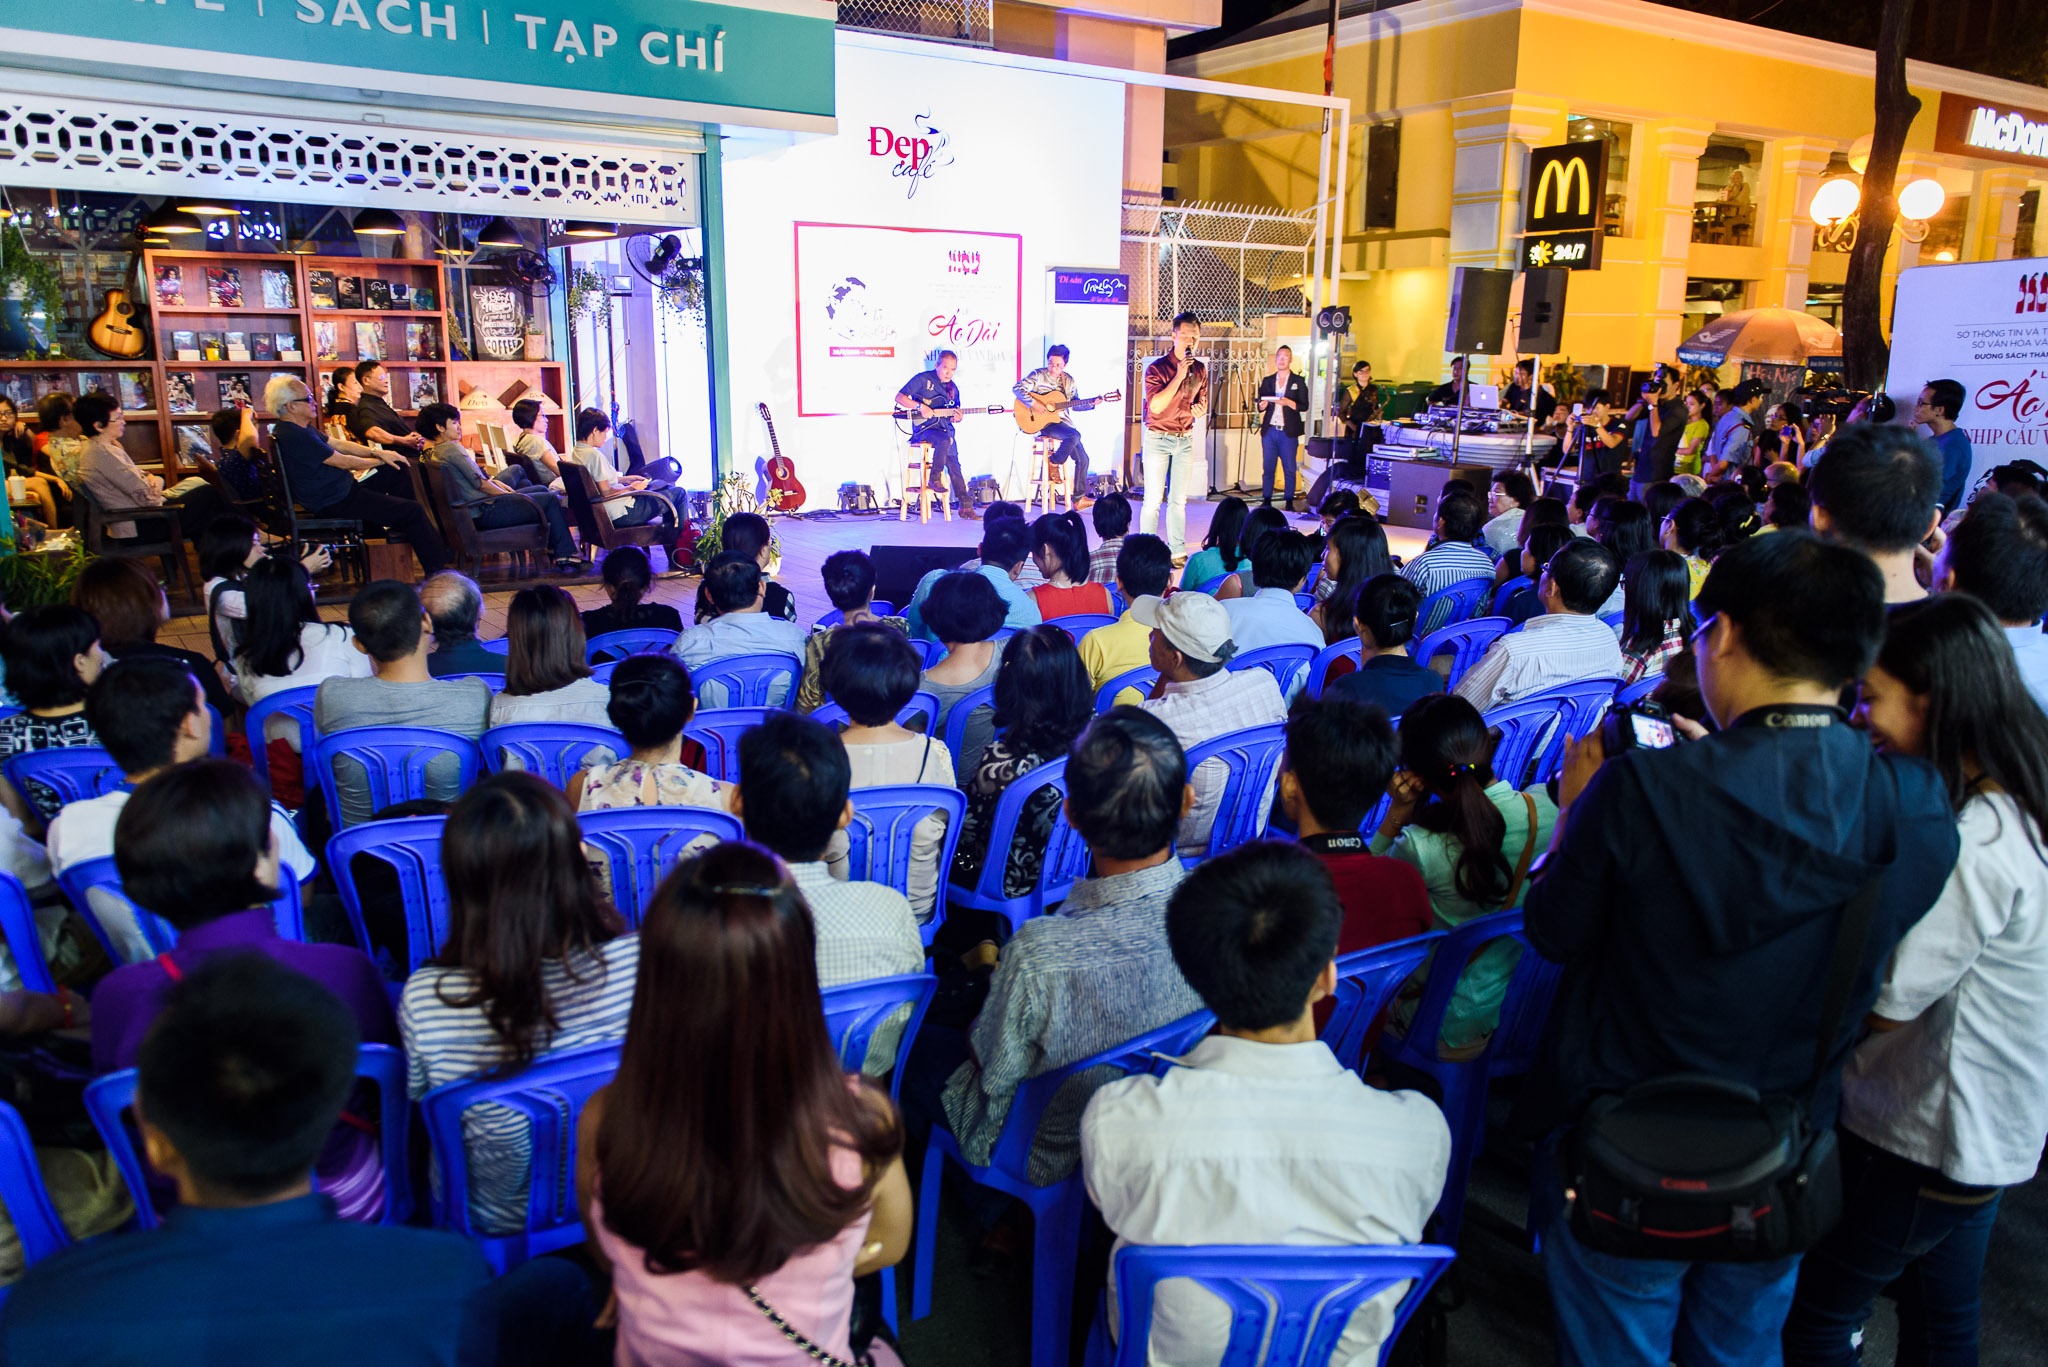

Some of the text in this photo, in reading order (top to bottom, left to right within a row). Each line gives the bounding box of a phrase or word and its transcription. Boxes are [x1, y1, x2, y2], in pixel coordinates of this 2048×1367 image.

[514, 13, 618, 64] TẠP
[639, 31, 727, 73] CHÍ
[868, 126, 936, 199] Đẹp café
[1552, 243, 1586, 261] 24/7
[2008, 328, 2023, 336] TIN
[487, 339, 518, 355] COFFEE
[1975, 369, 2045, 423] Áo
[1764, 711, 1831, 728] Canon
[1327, 837, 1362, 848] Canon
[1661, 1178, 1708, 1191] Canon
